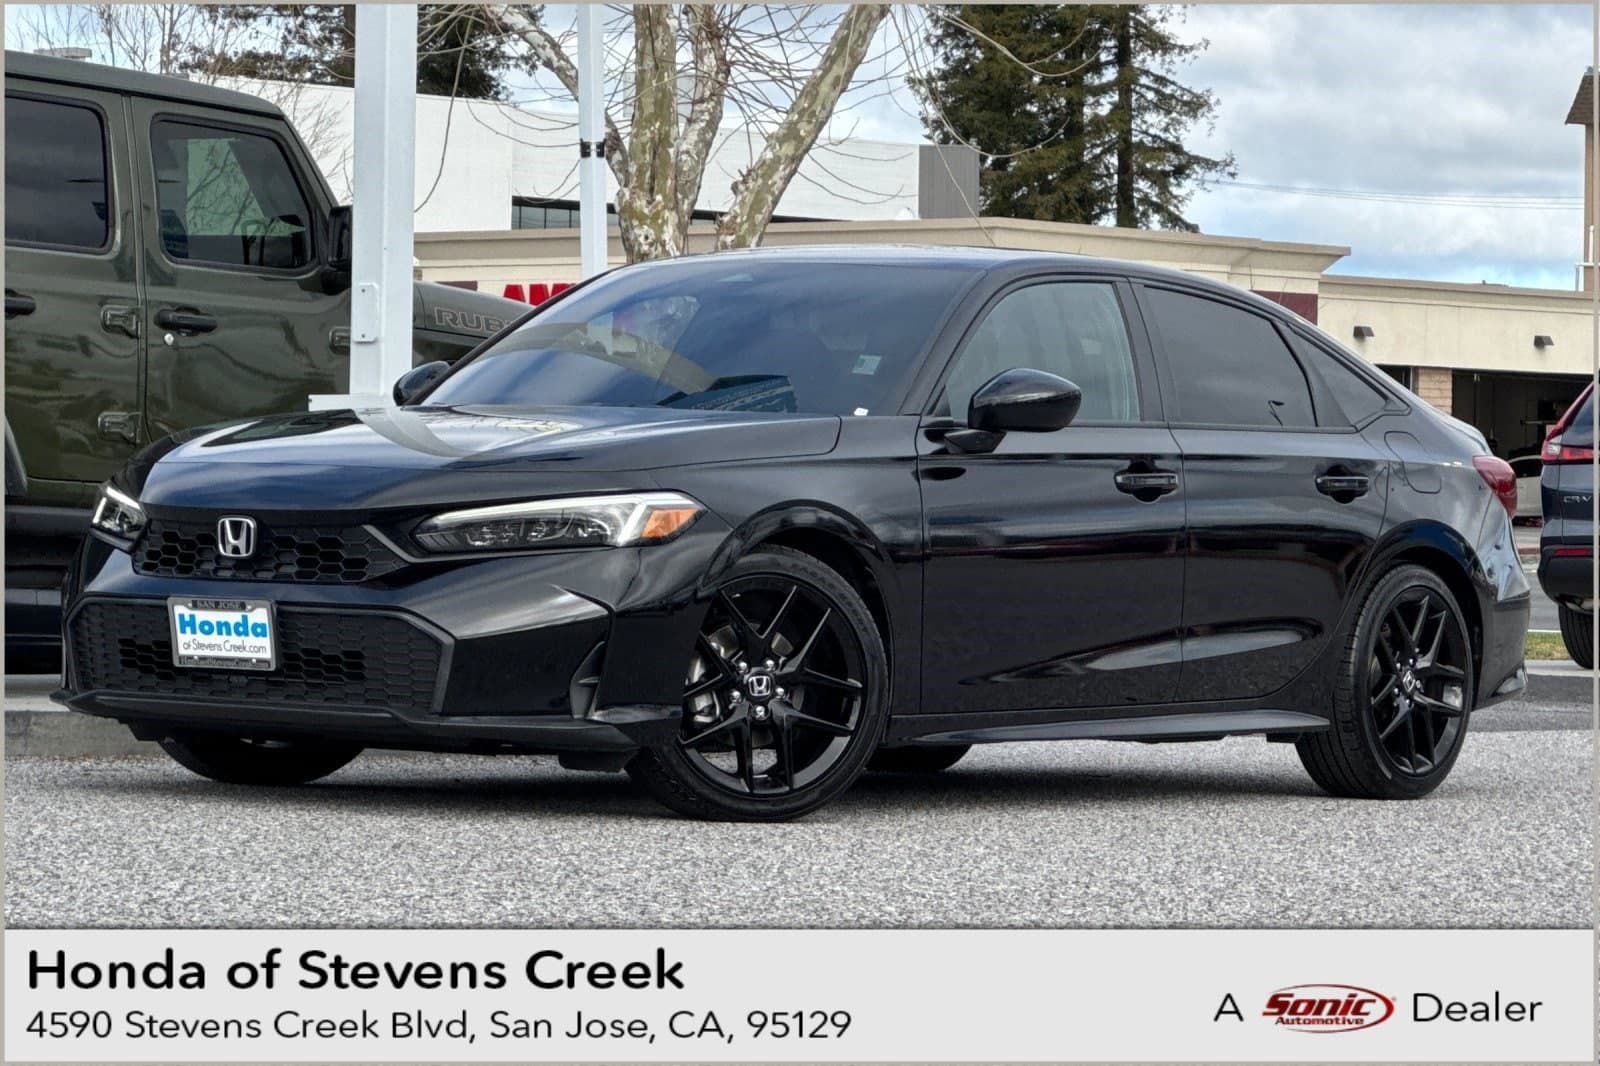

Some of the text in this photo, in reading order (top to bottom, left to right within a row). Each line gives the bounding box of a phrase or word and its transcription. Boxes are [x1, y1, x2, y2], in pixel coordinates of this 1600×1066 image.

[197, 600, 242, 609] SAN JOSE
[178, 613, 267, 638] Honda
[182, 638, 267, 655] of Stevens Creek.com
